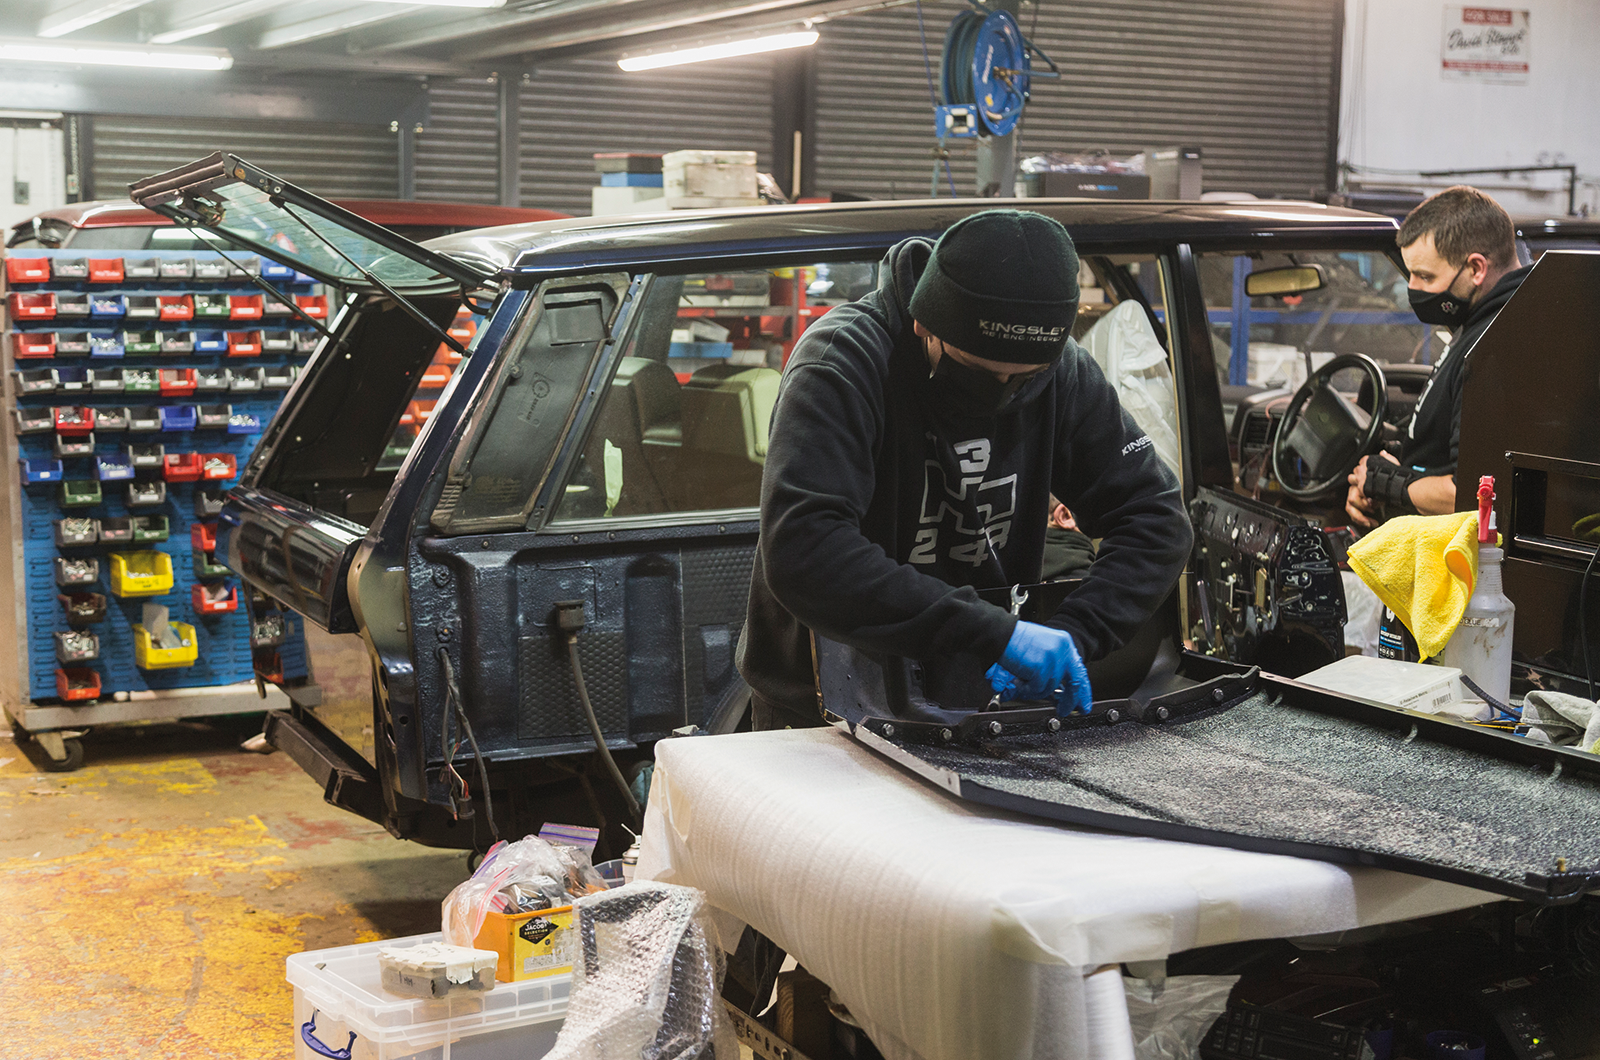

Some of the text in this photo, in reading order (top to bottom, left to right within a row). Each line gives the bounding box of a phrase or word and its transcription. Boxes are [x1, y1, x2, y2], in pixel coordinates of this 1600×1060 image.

[979, 319, 1065, 336] KINGSLEY
[954, 437, 991, 473] 3
[908, 528, 938, 564] 2
